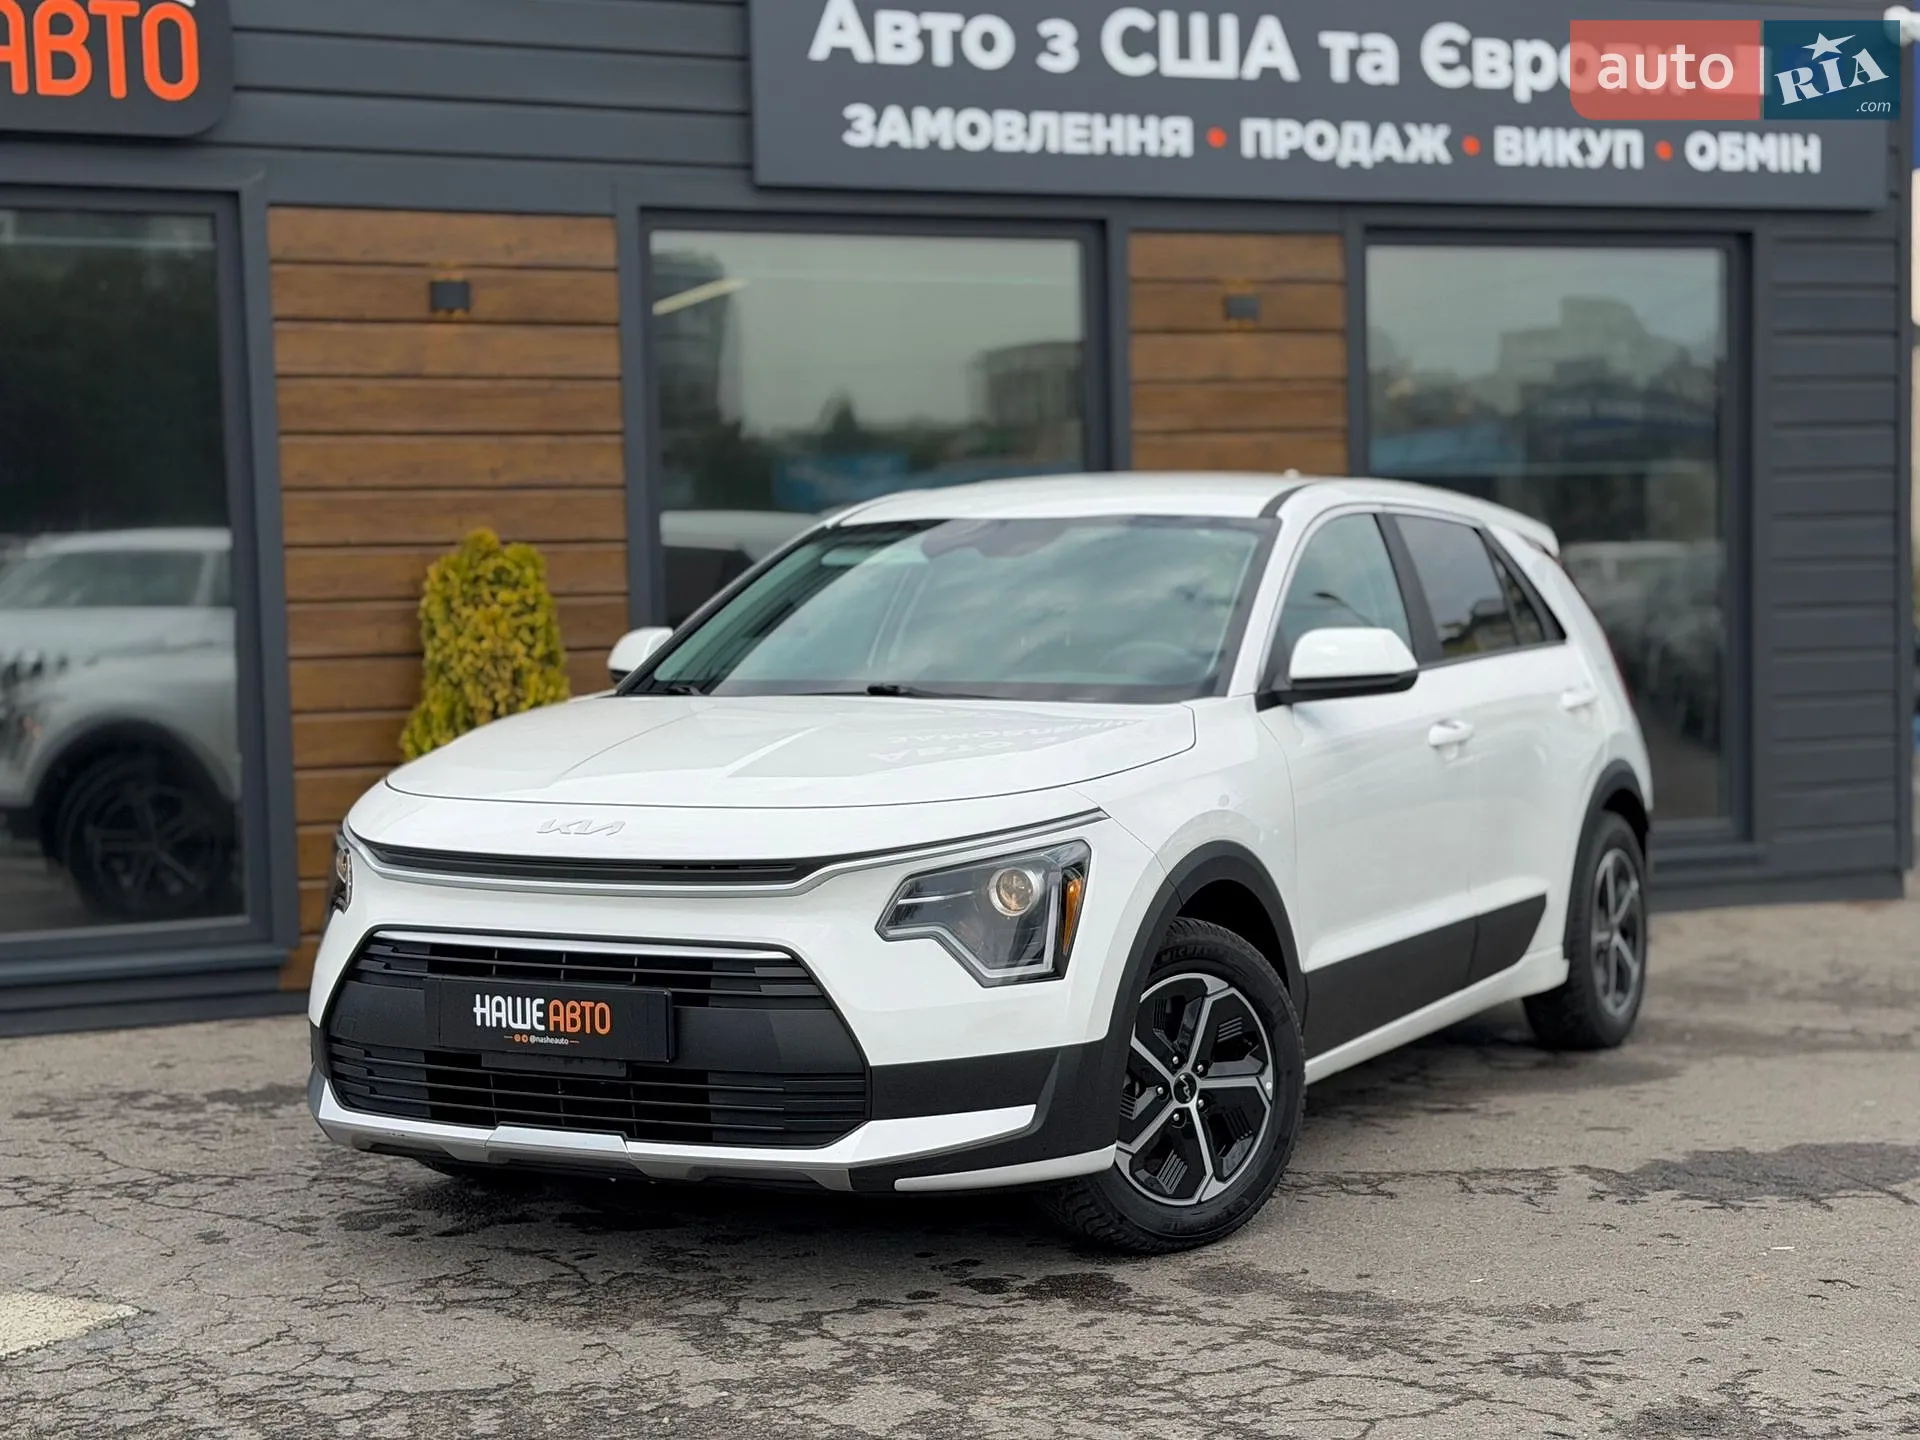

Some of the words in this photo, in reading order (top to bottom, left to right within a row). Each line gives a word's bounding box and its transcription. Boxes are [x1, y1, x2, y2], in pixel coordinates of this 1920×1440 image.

[808, 0, 1016, 70] Авто
[1100, 7, 1300, 82] США
[1318, 30, 1400, 86] та
[842, 103, 1194, 158] ЗАМОВЛЕННЯ
[1240, 117, 1452, 169] ПРОДАЖ
[1494, 125, 1644, 169] ВИКУП
[1684, 130, 1822, 173] ОБМІН
[537, 818, 626, 836] KIA
[473, 993, 546, 1031] НАШЕ
[549, 1000, 611, 1035] АВТО
